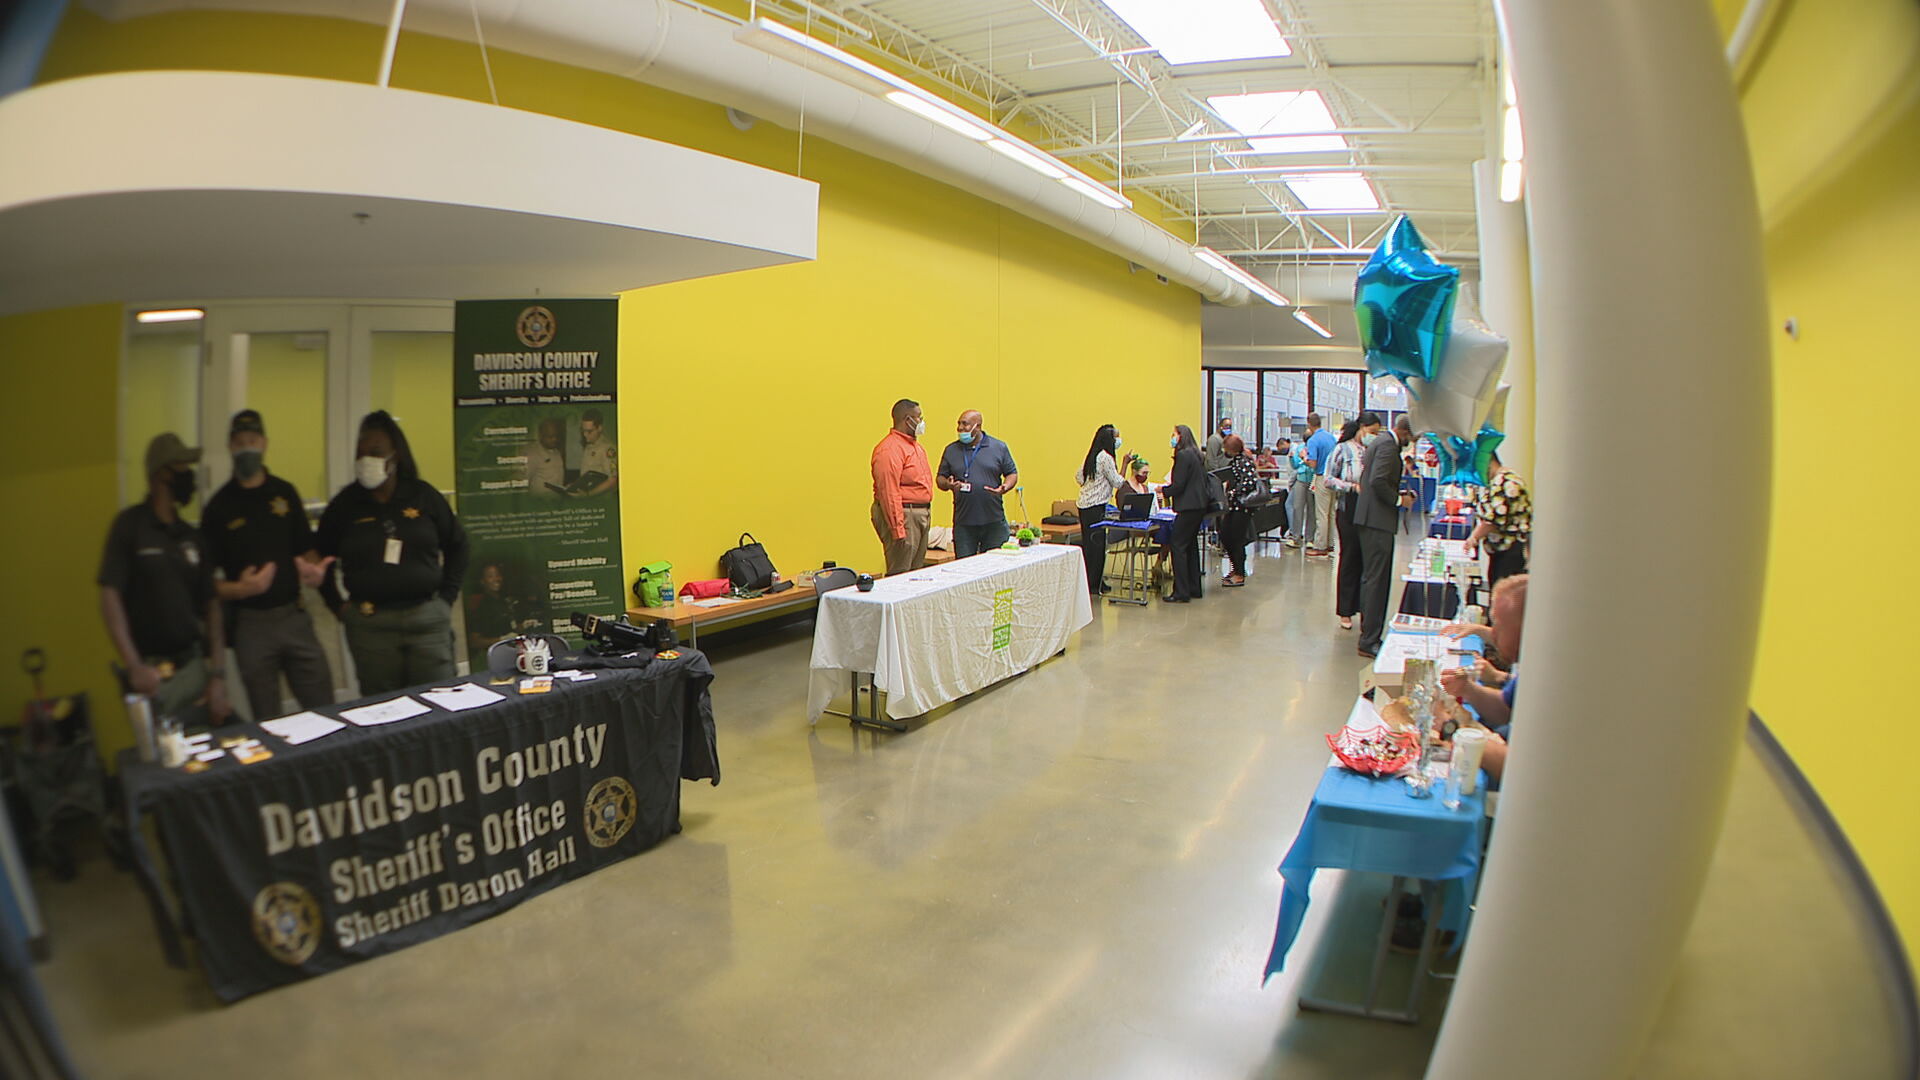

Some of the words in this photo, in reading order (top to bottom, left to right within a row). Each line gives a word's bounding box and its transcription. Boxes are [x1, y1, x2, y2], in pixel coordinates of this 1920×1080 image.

[473, 352, 542, 371] DAVIDSON
[544, 351, 599, 369] COUNTY
[546, 371, 591, 389] OFFICE
[260, 769, 465, 856] Davidson
[476, 723, 608, 795] County
[329, 824, 476, 904] Sheriff's
[482, 800, 567, 856] Office
[335, 890, 431, 949] Sheriff
[437, 867, 525, 912] Daron
[527, 836, 577, 880] Hall
